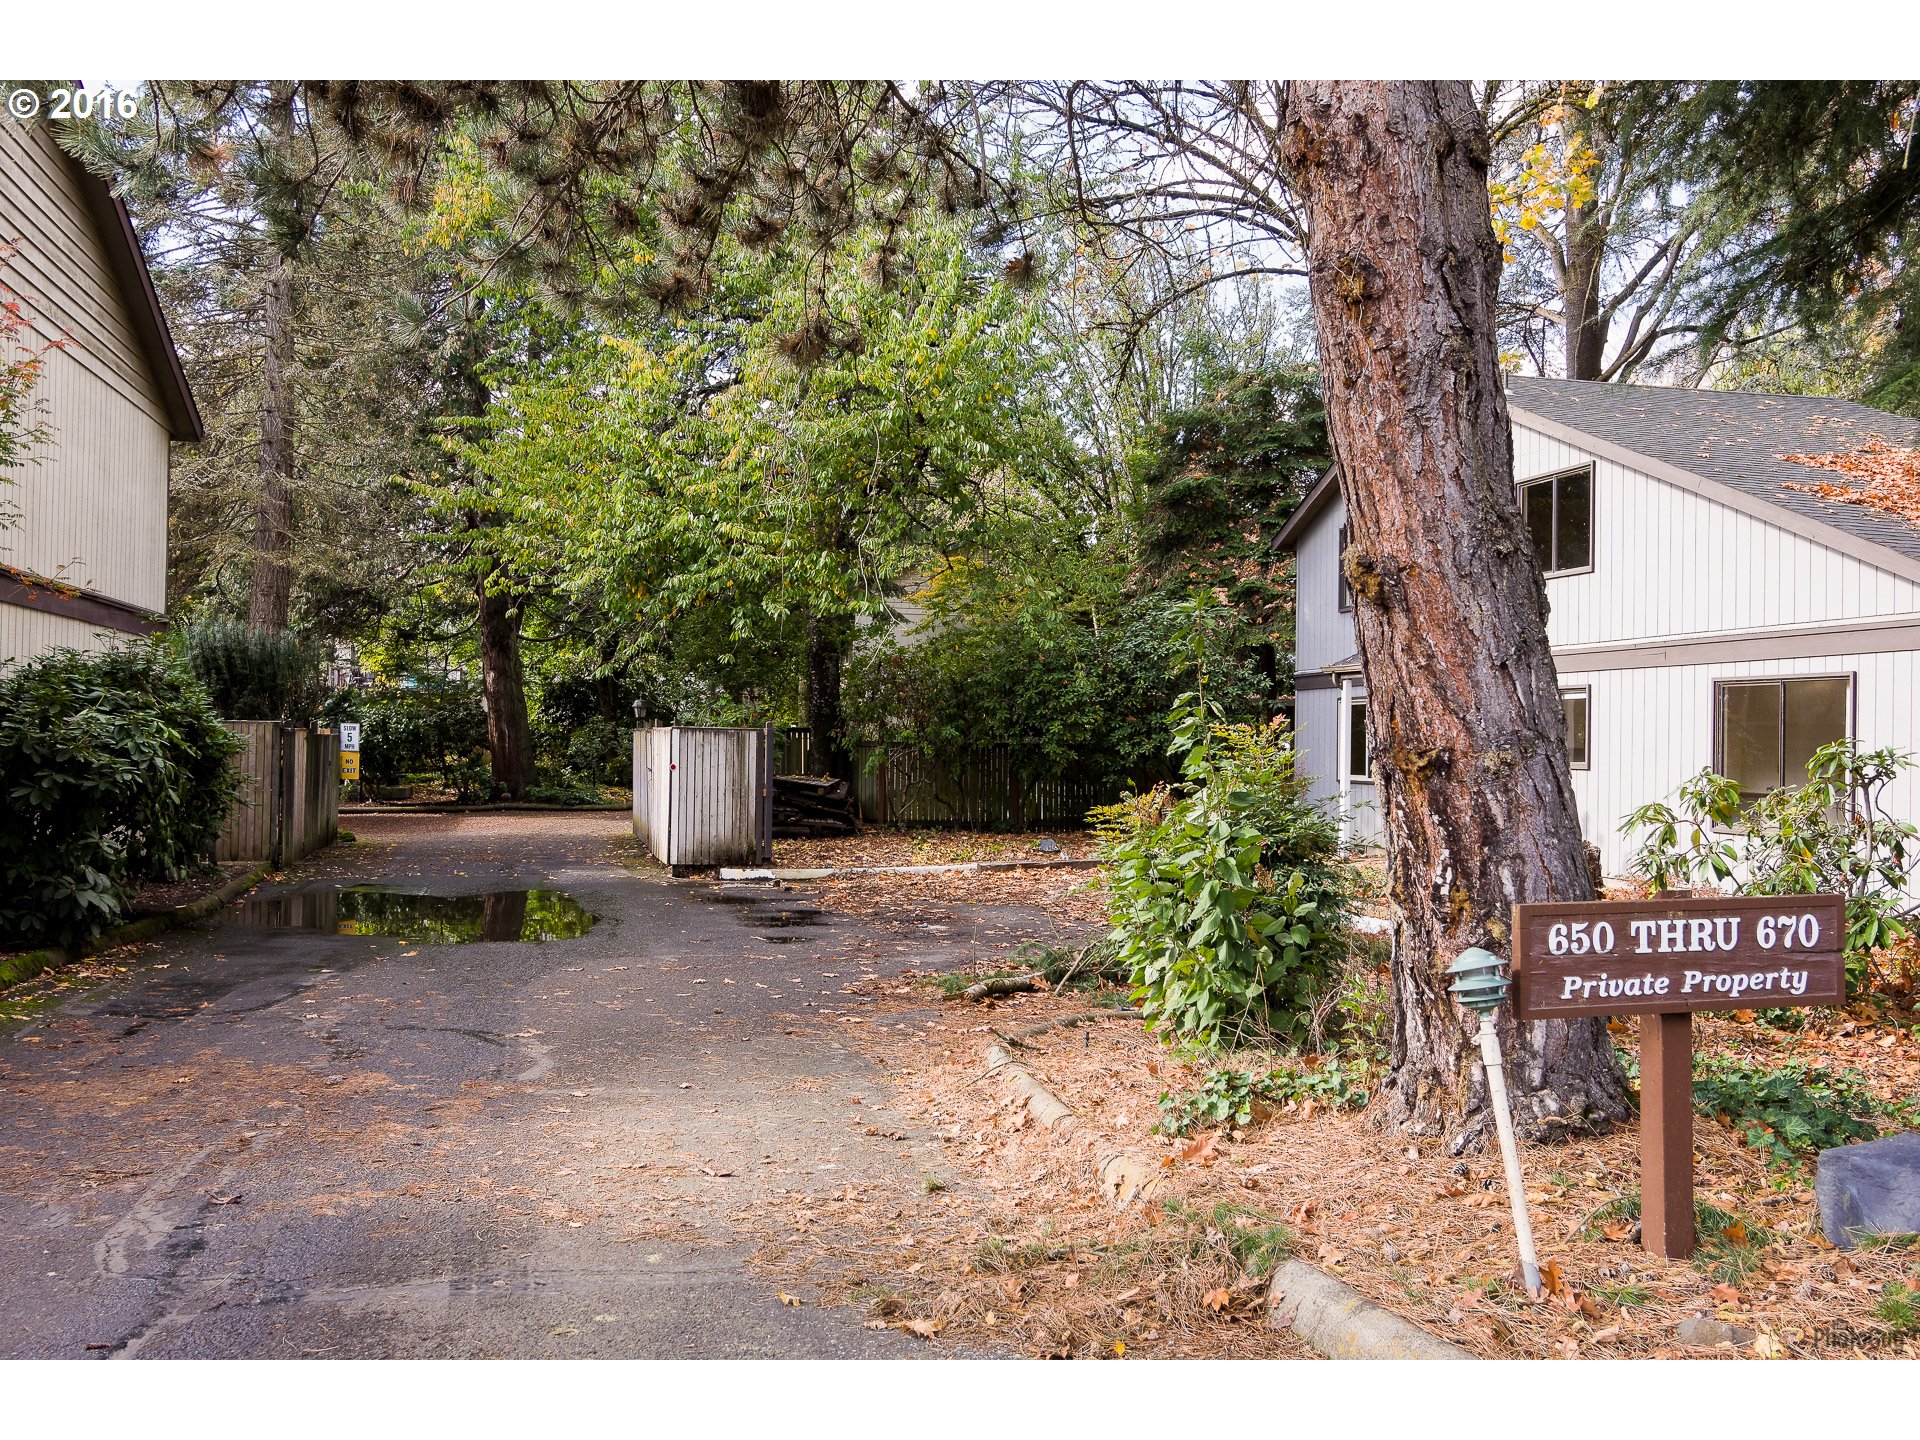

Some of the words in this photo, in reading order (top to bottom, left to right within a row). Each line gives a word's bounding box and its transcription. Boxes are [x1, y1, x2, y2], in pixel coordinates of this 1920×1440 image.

[347, 732, 353, 742] 5
[1548, 920, 1615, 956] 650
[1630, 917, 1741, 954] THRU
[1756, 913, 1820, 949] 670
[1560, 972, 1669, 1000] Private
[1680, 966, 1809, 998] Property
